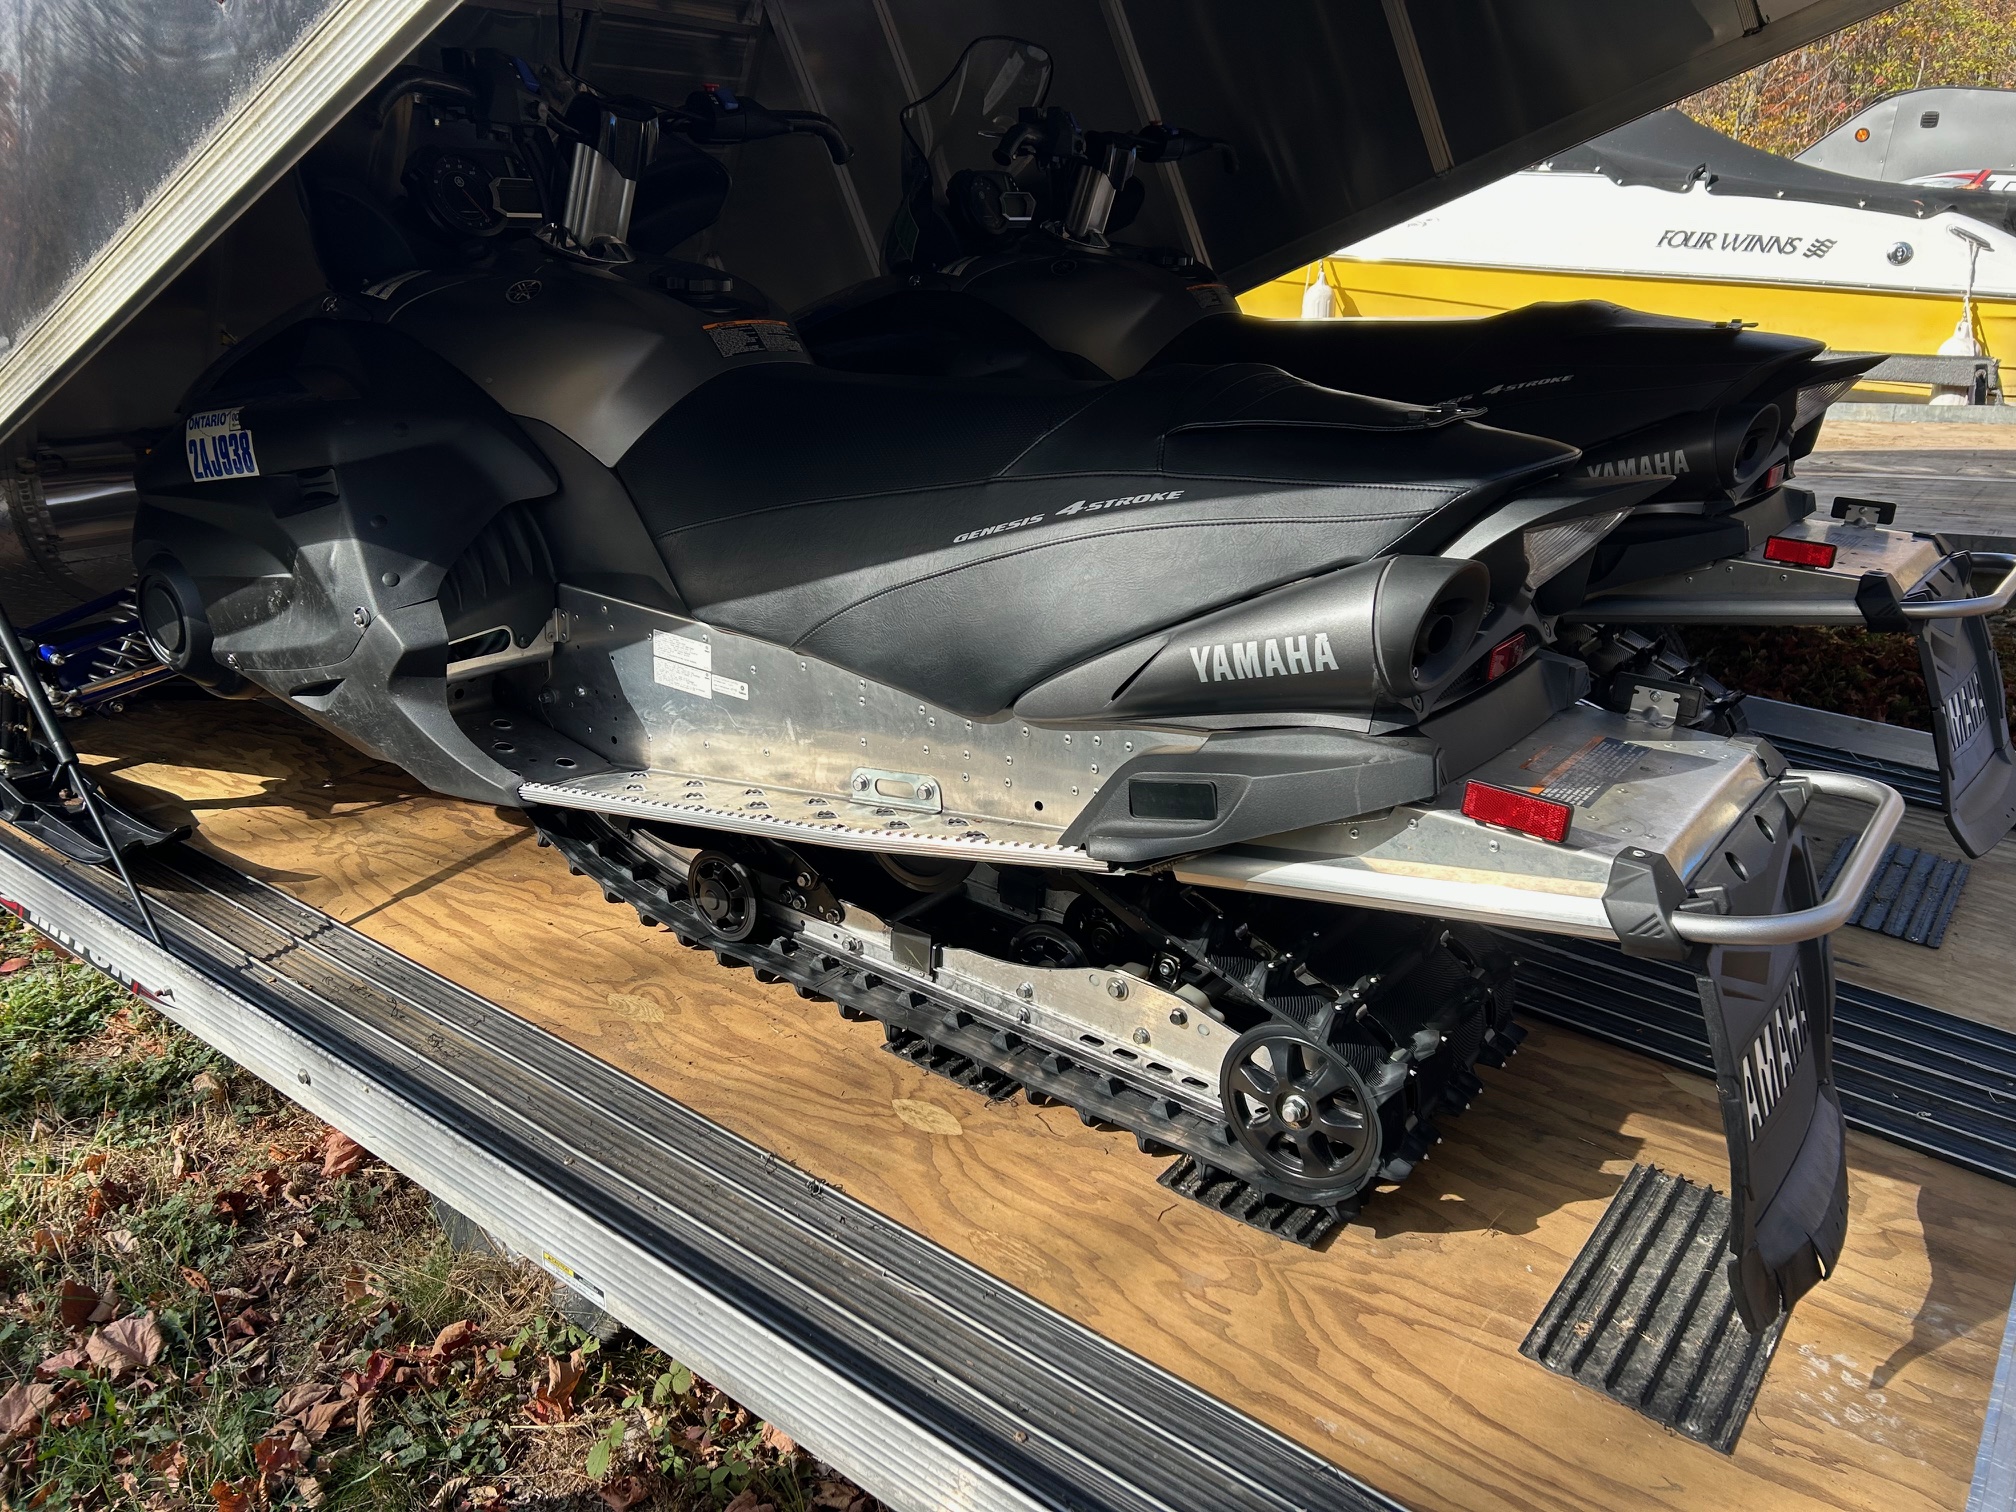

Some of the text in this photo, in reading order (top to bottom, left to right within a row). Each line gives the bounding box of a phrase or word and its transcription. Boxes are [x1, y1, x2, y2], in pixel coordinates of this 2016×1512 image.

[1656, 230, 1803, 255] FOUR WINNS
[188, 412, 227, 430] ONTARIO
[188, 432, 256, 479] 2AJ938
[953, 513, 1046, 543] GENESIS
[1189, 632, 1340, 683] YAMAHA
[1742, 968, 1810, 1142] AMAHA
